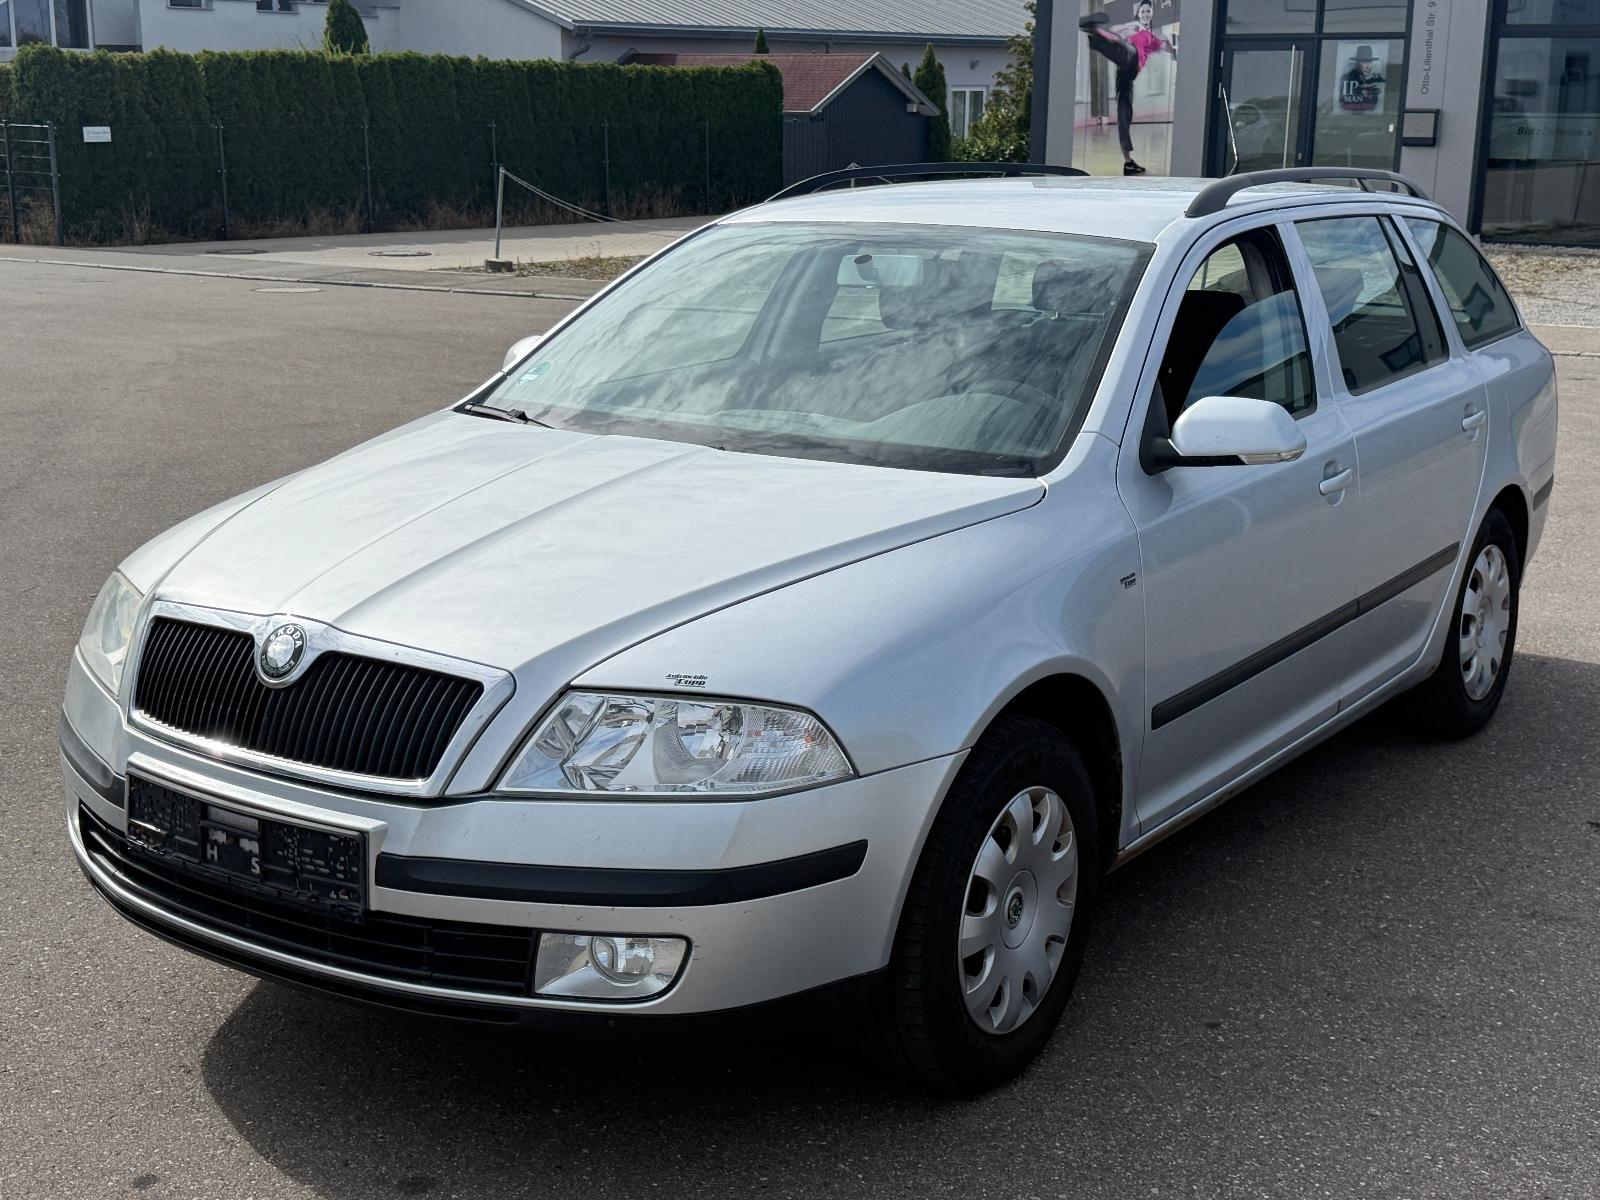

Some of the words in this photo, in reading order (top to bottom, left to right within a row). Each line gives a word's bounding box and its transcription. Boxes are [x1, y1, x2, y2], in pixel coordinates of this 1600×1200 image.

[1420, 29, 1434, 95] Otto-Lilienthal
[1343, 80, 1359, 96] IP
[1344, 95, 1363, 103] MAN
